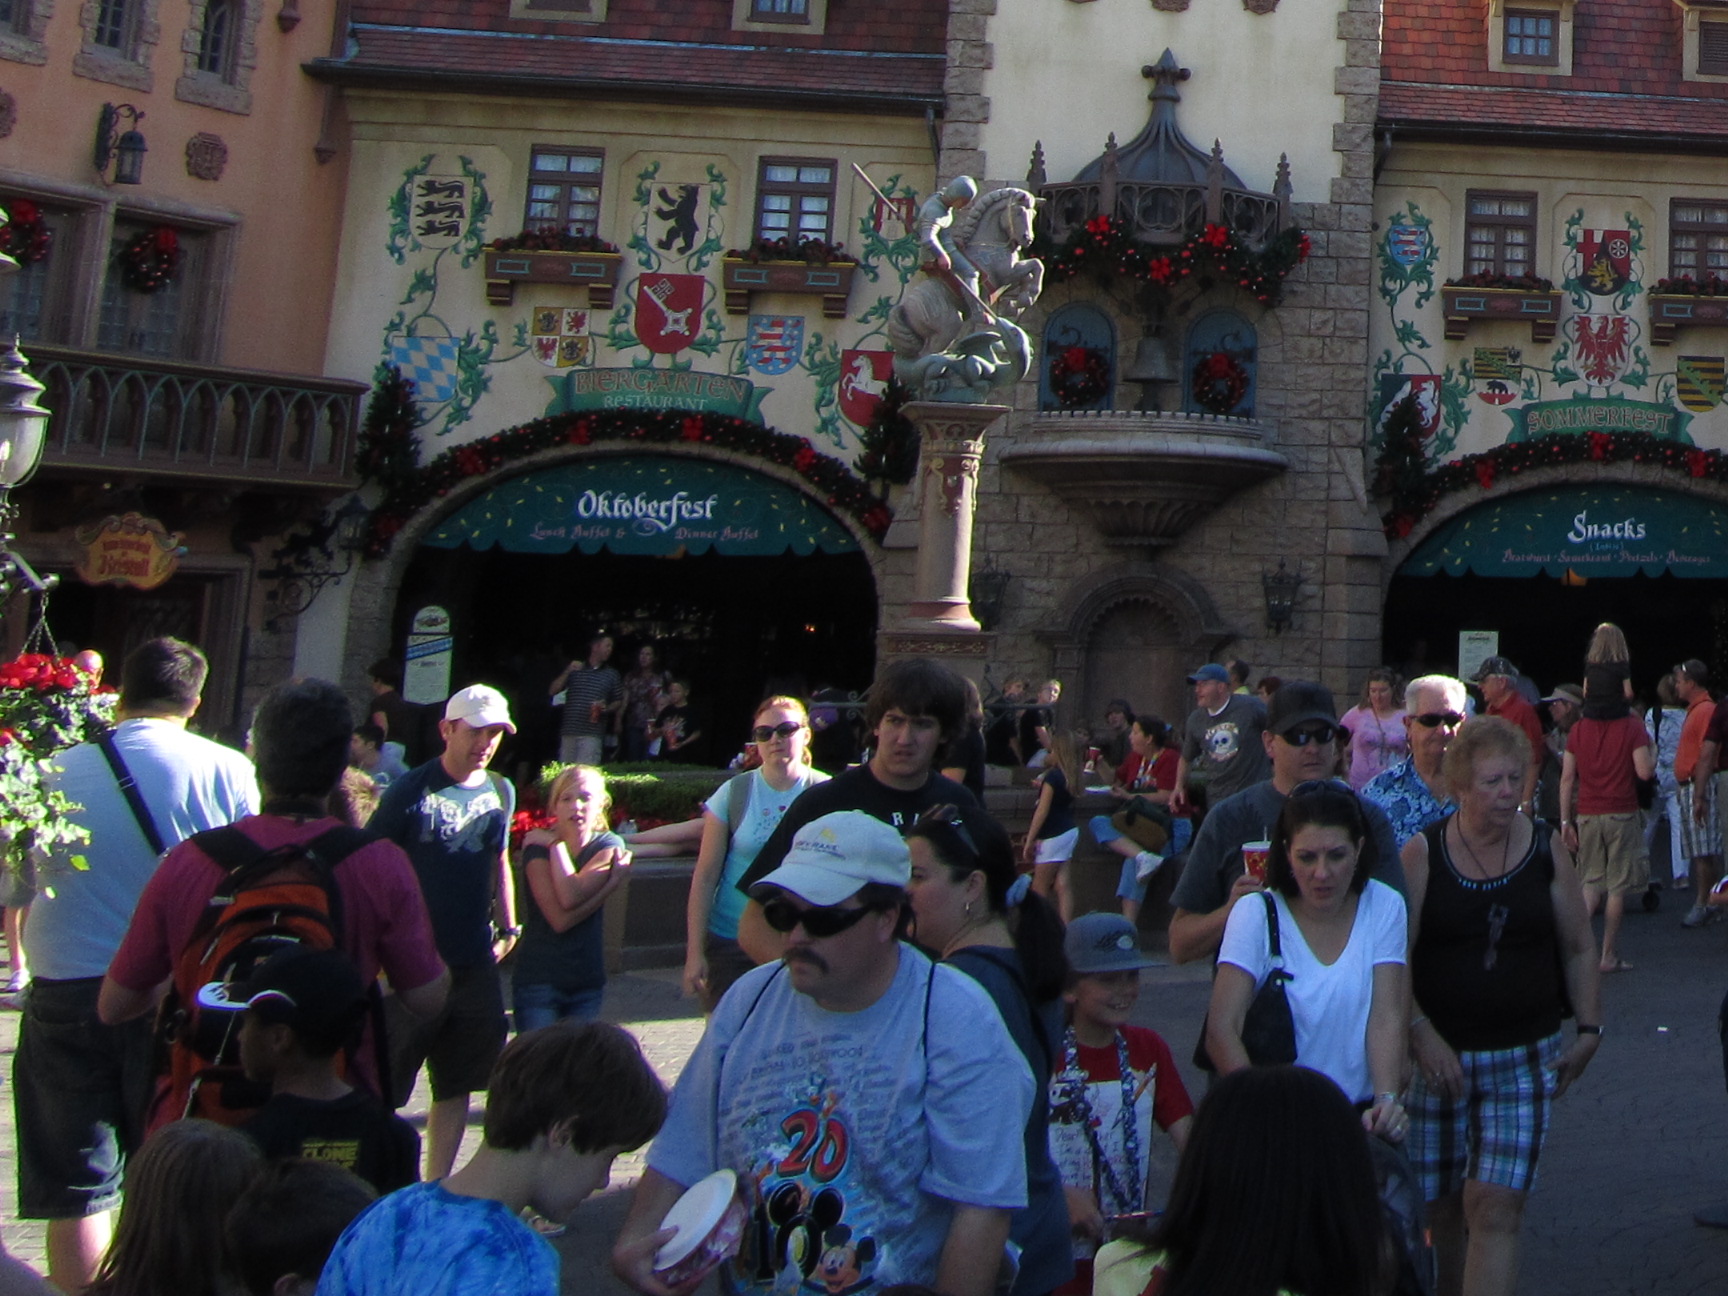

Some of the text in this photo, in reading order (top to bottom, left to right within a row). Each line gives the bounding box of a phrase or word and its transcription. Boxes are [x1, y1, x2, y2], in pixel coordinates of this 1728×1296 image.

[604, 394, 708, 410] RESTAURANT
[1527, 406, 1675, 435] SOMMERFEST
[576, 489, 718, 532] Oktoberfest
[1567, 509, 1646, 543] Snacks
[570, 523, 610, 541] Buffet
[675, 526, 718, 540] Dinner
[719, 524, 759, 541] Buffet
[777, 1109, 848, 1183] 20
